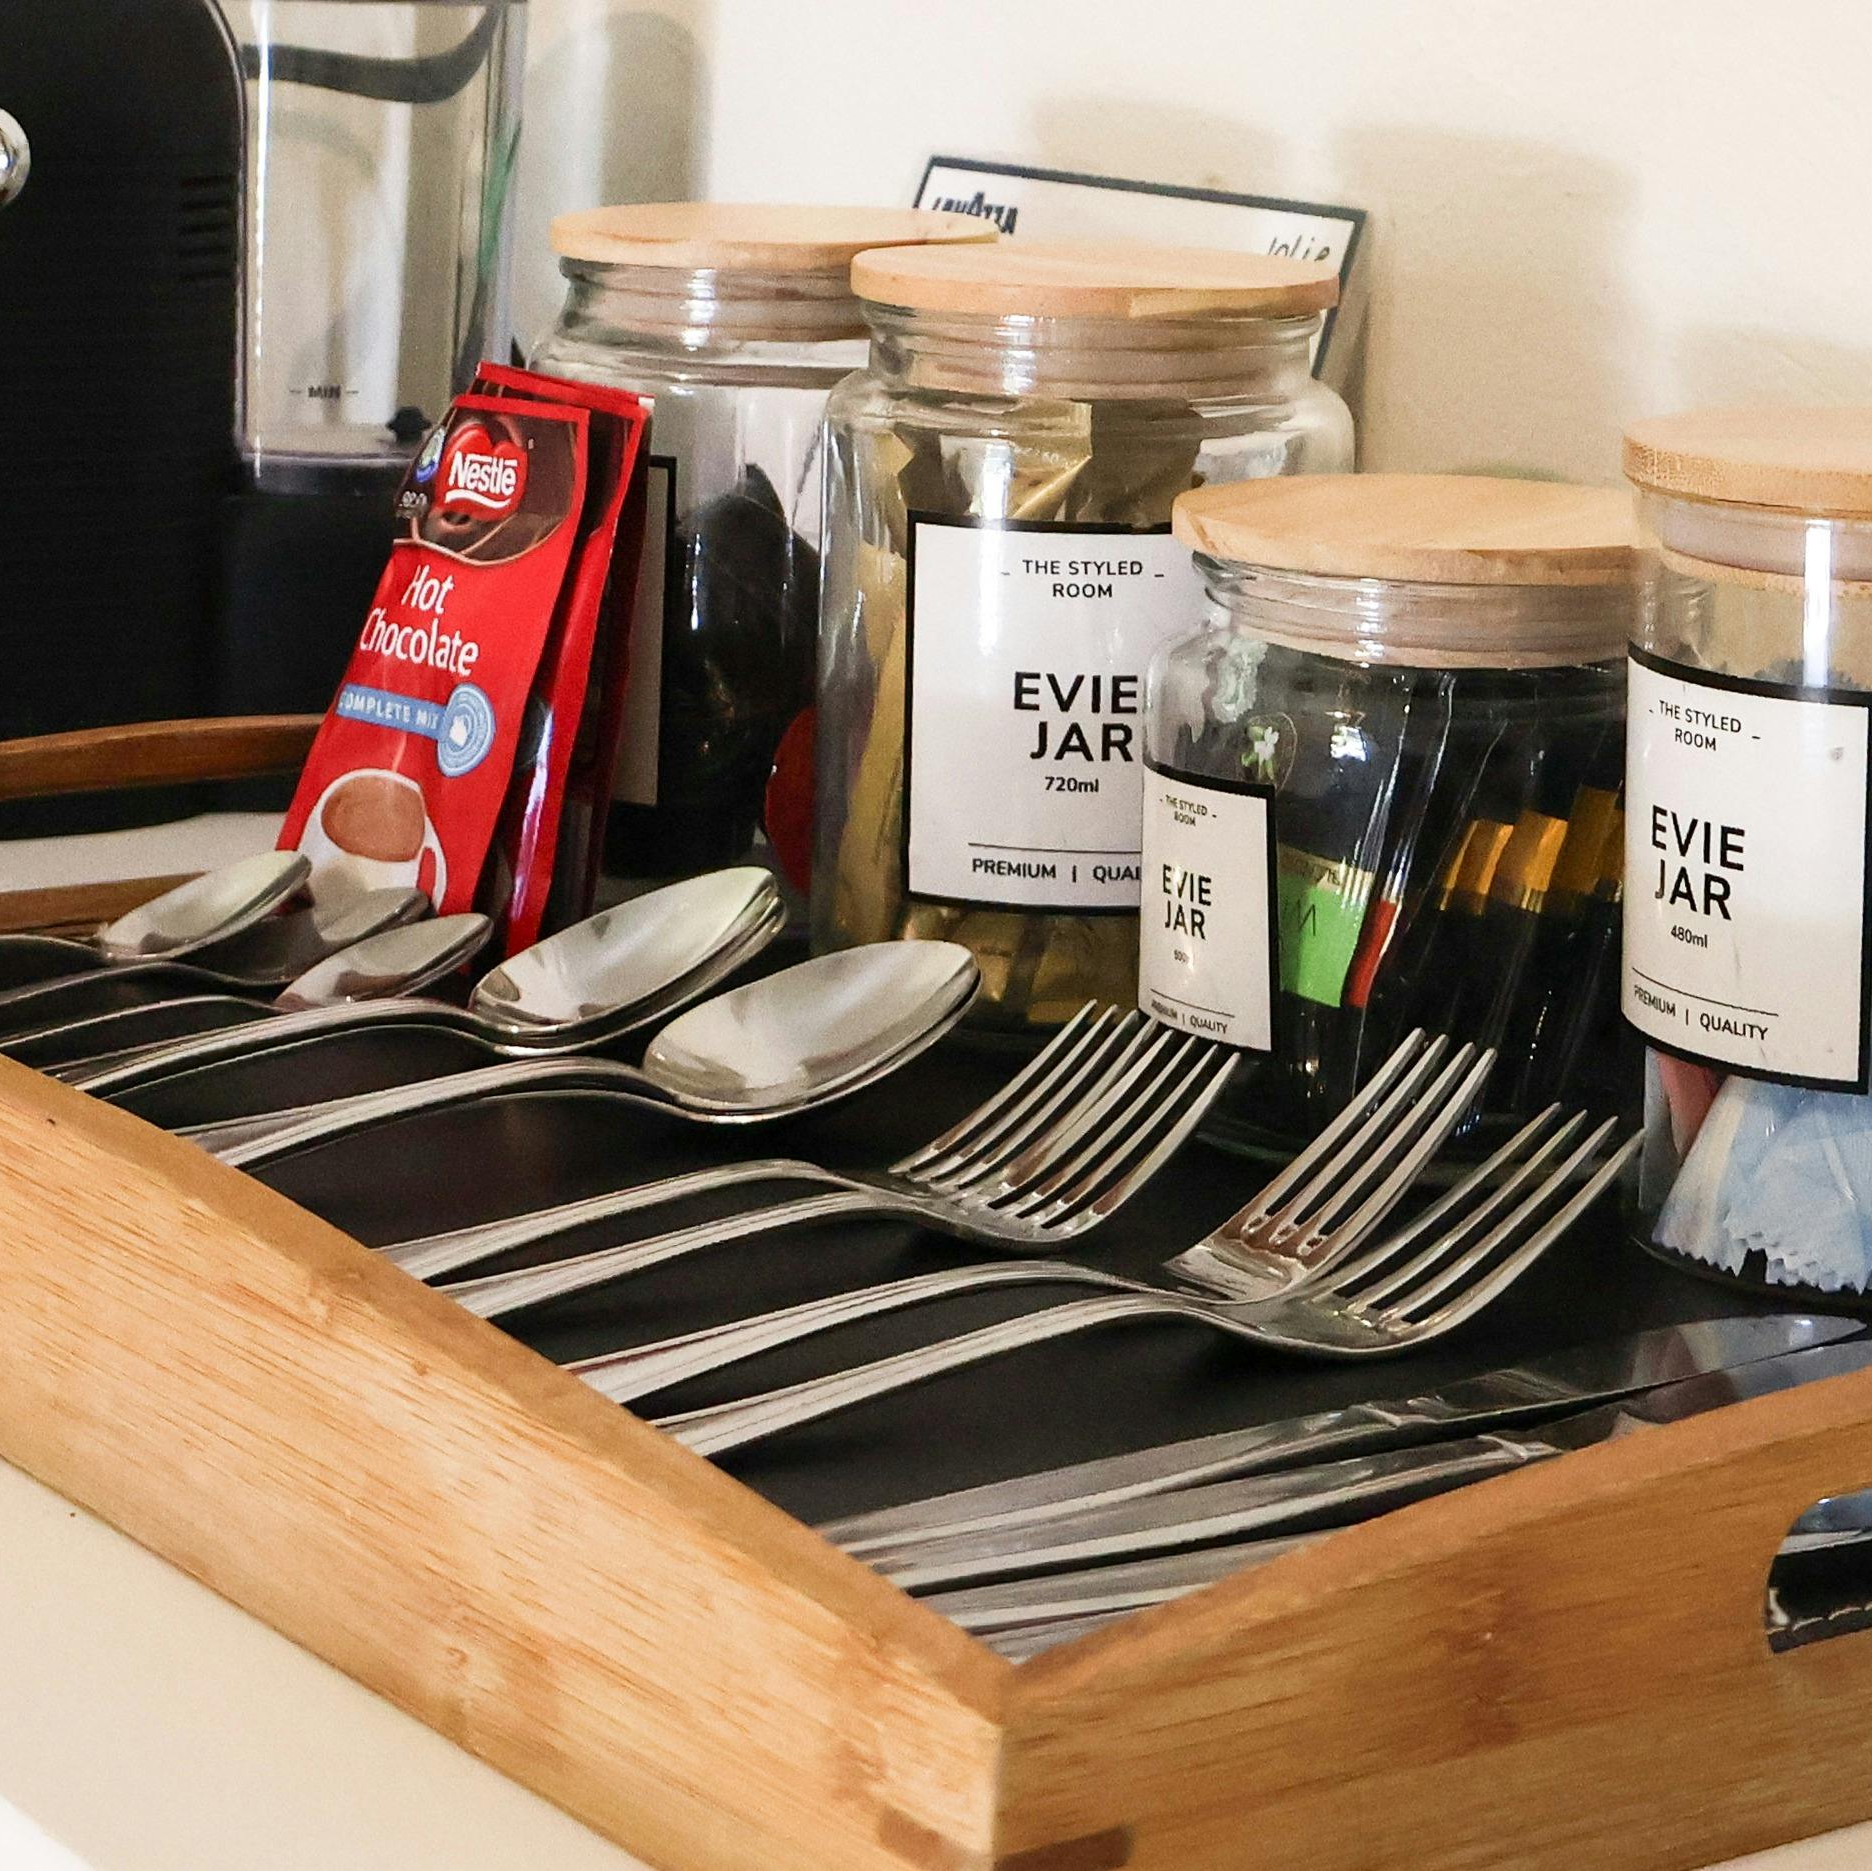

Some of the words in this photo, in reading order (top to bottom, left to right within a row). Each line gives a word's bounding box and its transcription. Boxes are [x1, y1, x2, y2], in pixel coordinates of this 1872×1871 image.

[308, 385, 341, 399] MIN
[448, 450, 518, 496] Nestlé
[1022, 559, 1061, 576] THE
[1068, 560, 1143, 576] STYLED
[401, 564, 455, 615] Hot
[1052, 583, 1113, 599] ROOM
[359, 607, 479, 677] Chocolate
[1013, 671, 1139, 715] EVIE
[1659, 699, 1681, 720] THE
[1684, 708, 1742, 734] STYLED
[1030, 721, 1134, 762] JAR
[1674, 728, 1717, 752] ROOM
[1044, 776, 1099, 793] 720ml
[1651, 804, 1746, 872] EVIE
[972, 858, 1057, 879] PREMIUM
[1162, 863, 1213, 906] EVIE
[1654, 859, 1733, 921] JAR
[1164, 900, 1207, 941] JAR
[1670, 924, 1708, 949] 480ml
[1190, 1014, 1228, 1034] QUALITY
[1633, 984, 1676, 1018] PREMIUM
[1699, 1011, 1769, 1041] QUALITY
